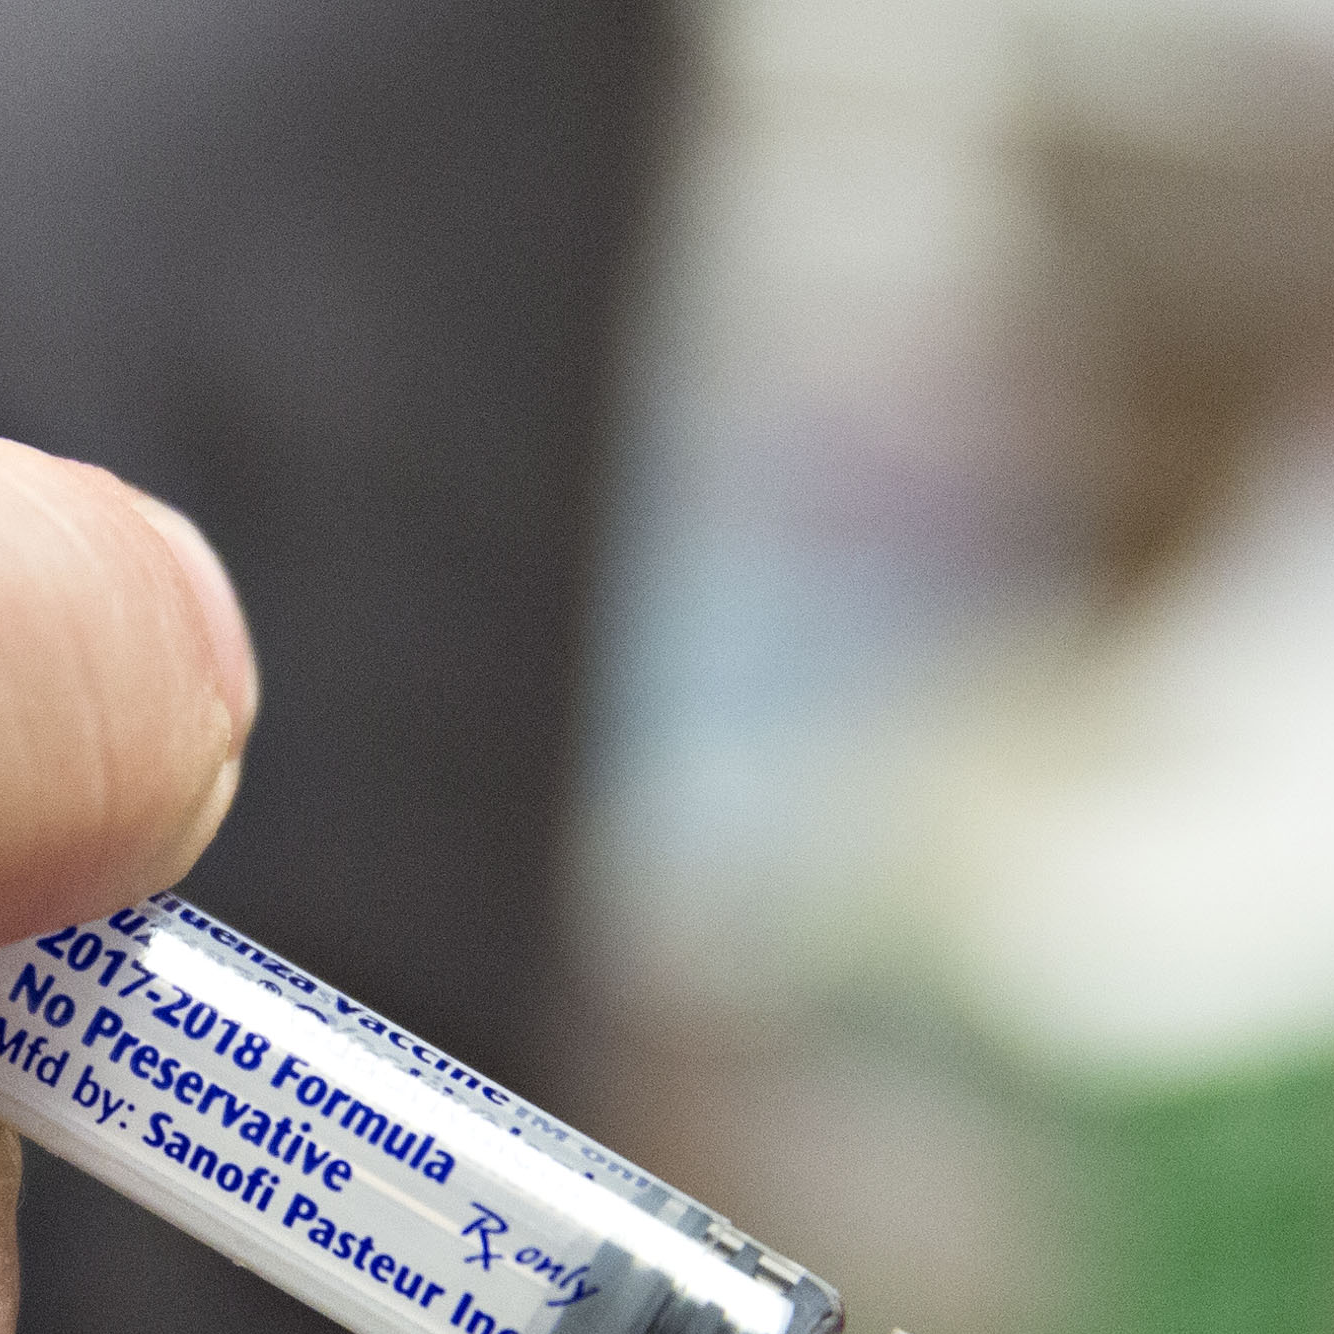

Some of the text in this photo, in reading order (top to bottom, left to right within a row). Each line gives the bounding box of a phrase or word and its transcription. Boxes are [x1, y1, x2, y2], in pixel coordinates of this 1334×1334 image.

[8, 962, 77, 1028] No
[81, 1006, 353, 1193] Preservative
[36, 925, 272, 1072] 2017-2018
[269, 1054, 457, 1186] Formula
[333, 996, 511, 1106] Vaccine
[71, 1064, 137, 1130] by:
[142, 1111, 282, 1213] Sanofi
[281, 1192, 447, 1310] Pasteur
[513, 1245, 601, 1308] only
